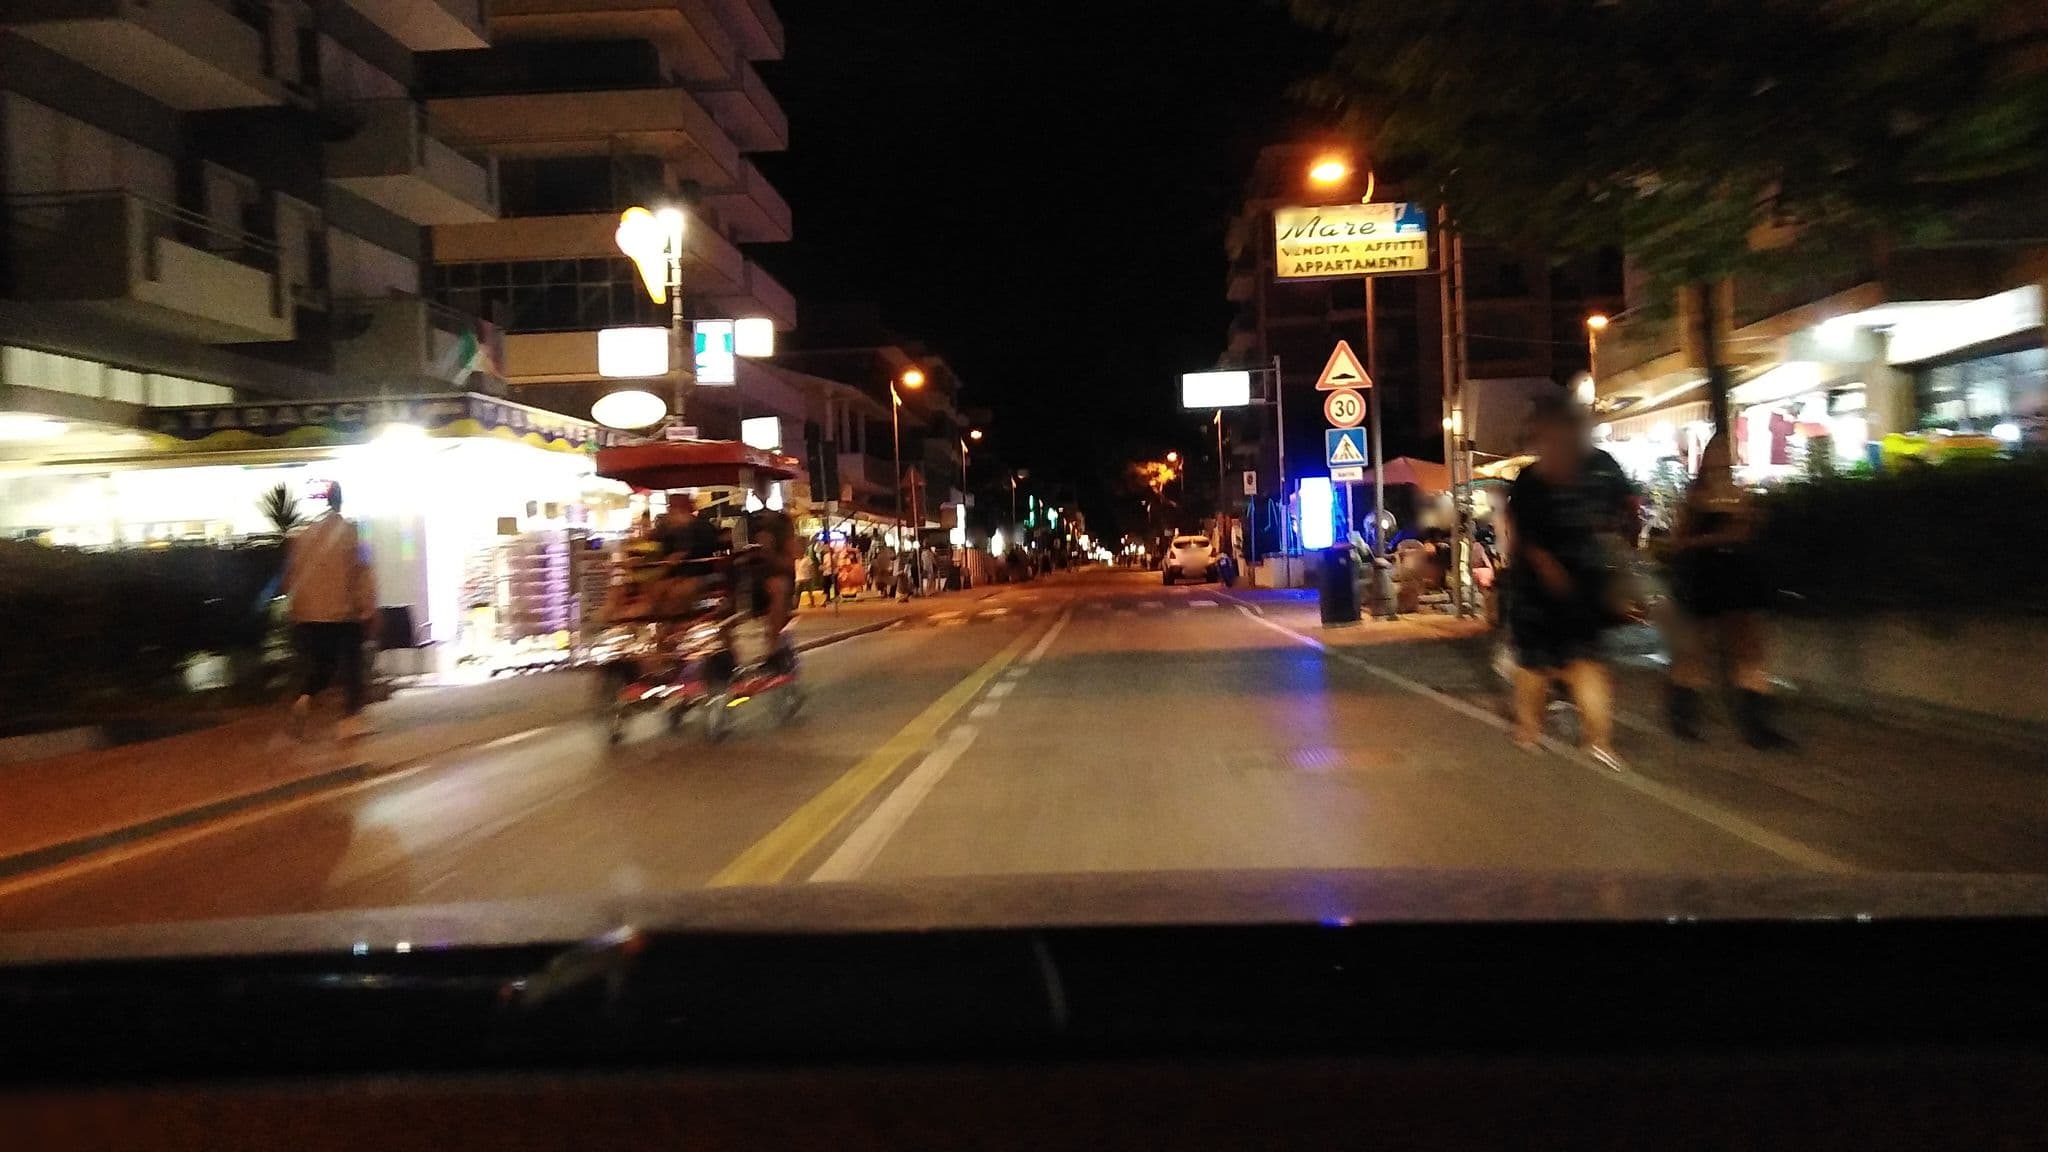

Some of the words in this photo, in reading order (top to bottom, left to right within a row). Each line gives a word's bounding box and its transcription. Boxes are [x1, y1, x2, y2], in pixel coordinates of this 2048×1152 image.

[1280, 215, 1376, 241] Mare
[1365, 240, 1423, 252] AFFITTI
[1294, 256, 1413, 273] APPARTAMENTI
[1335, 400, 1356, 417] 30
